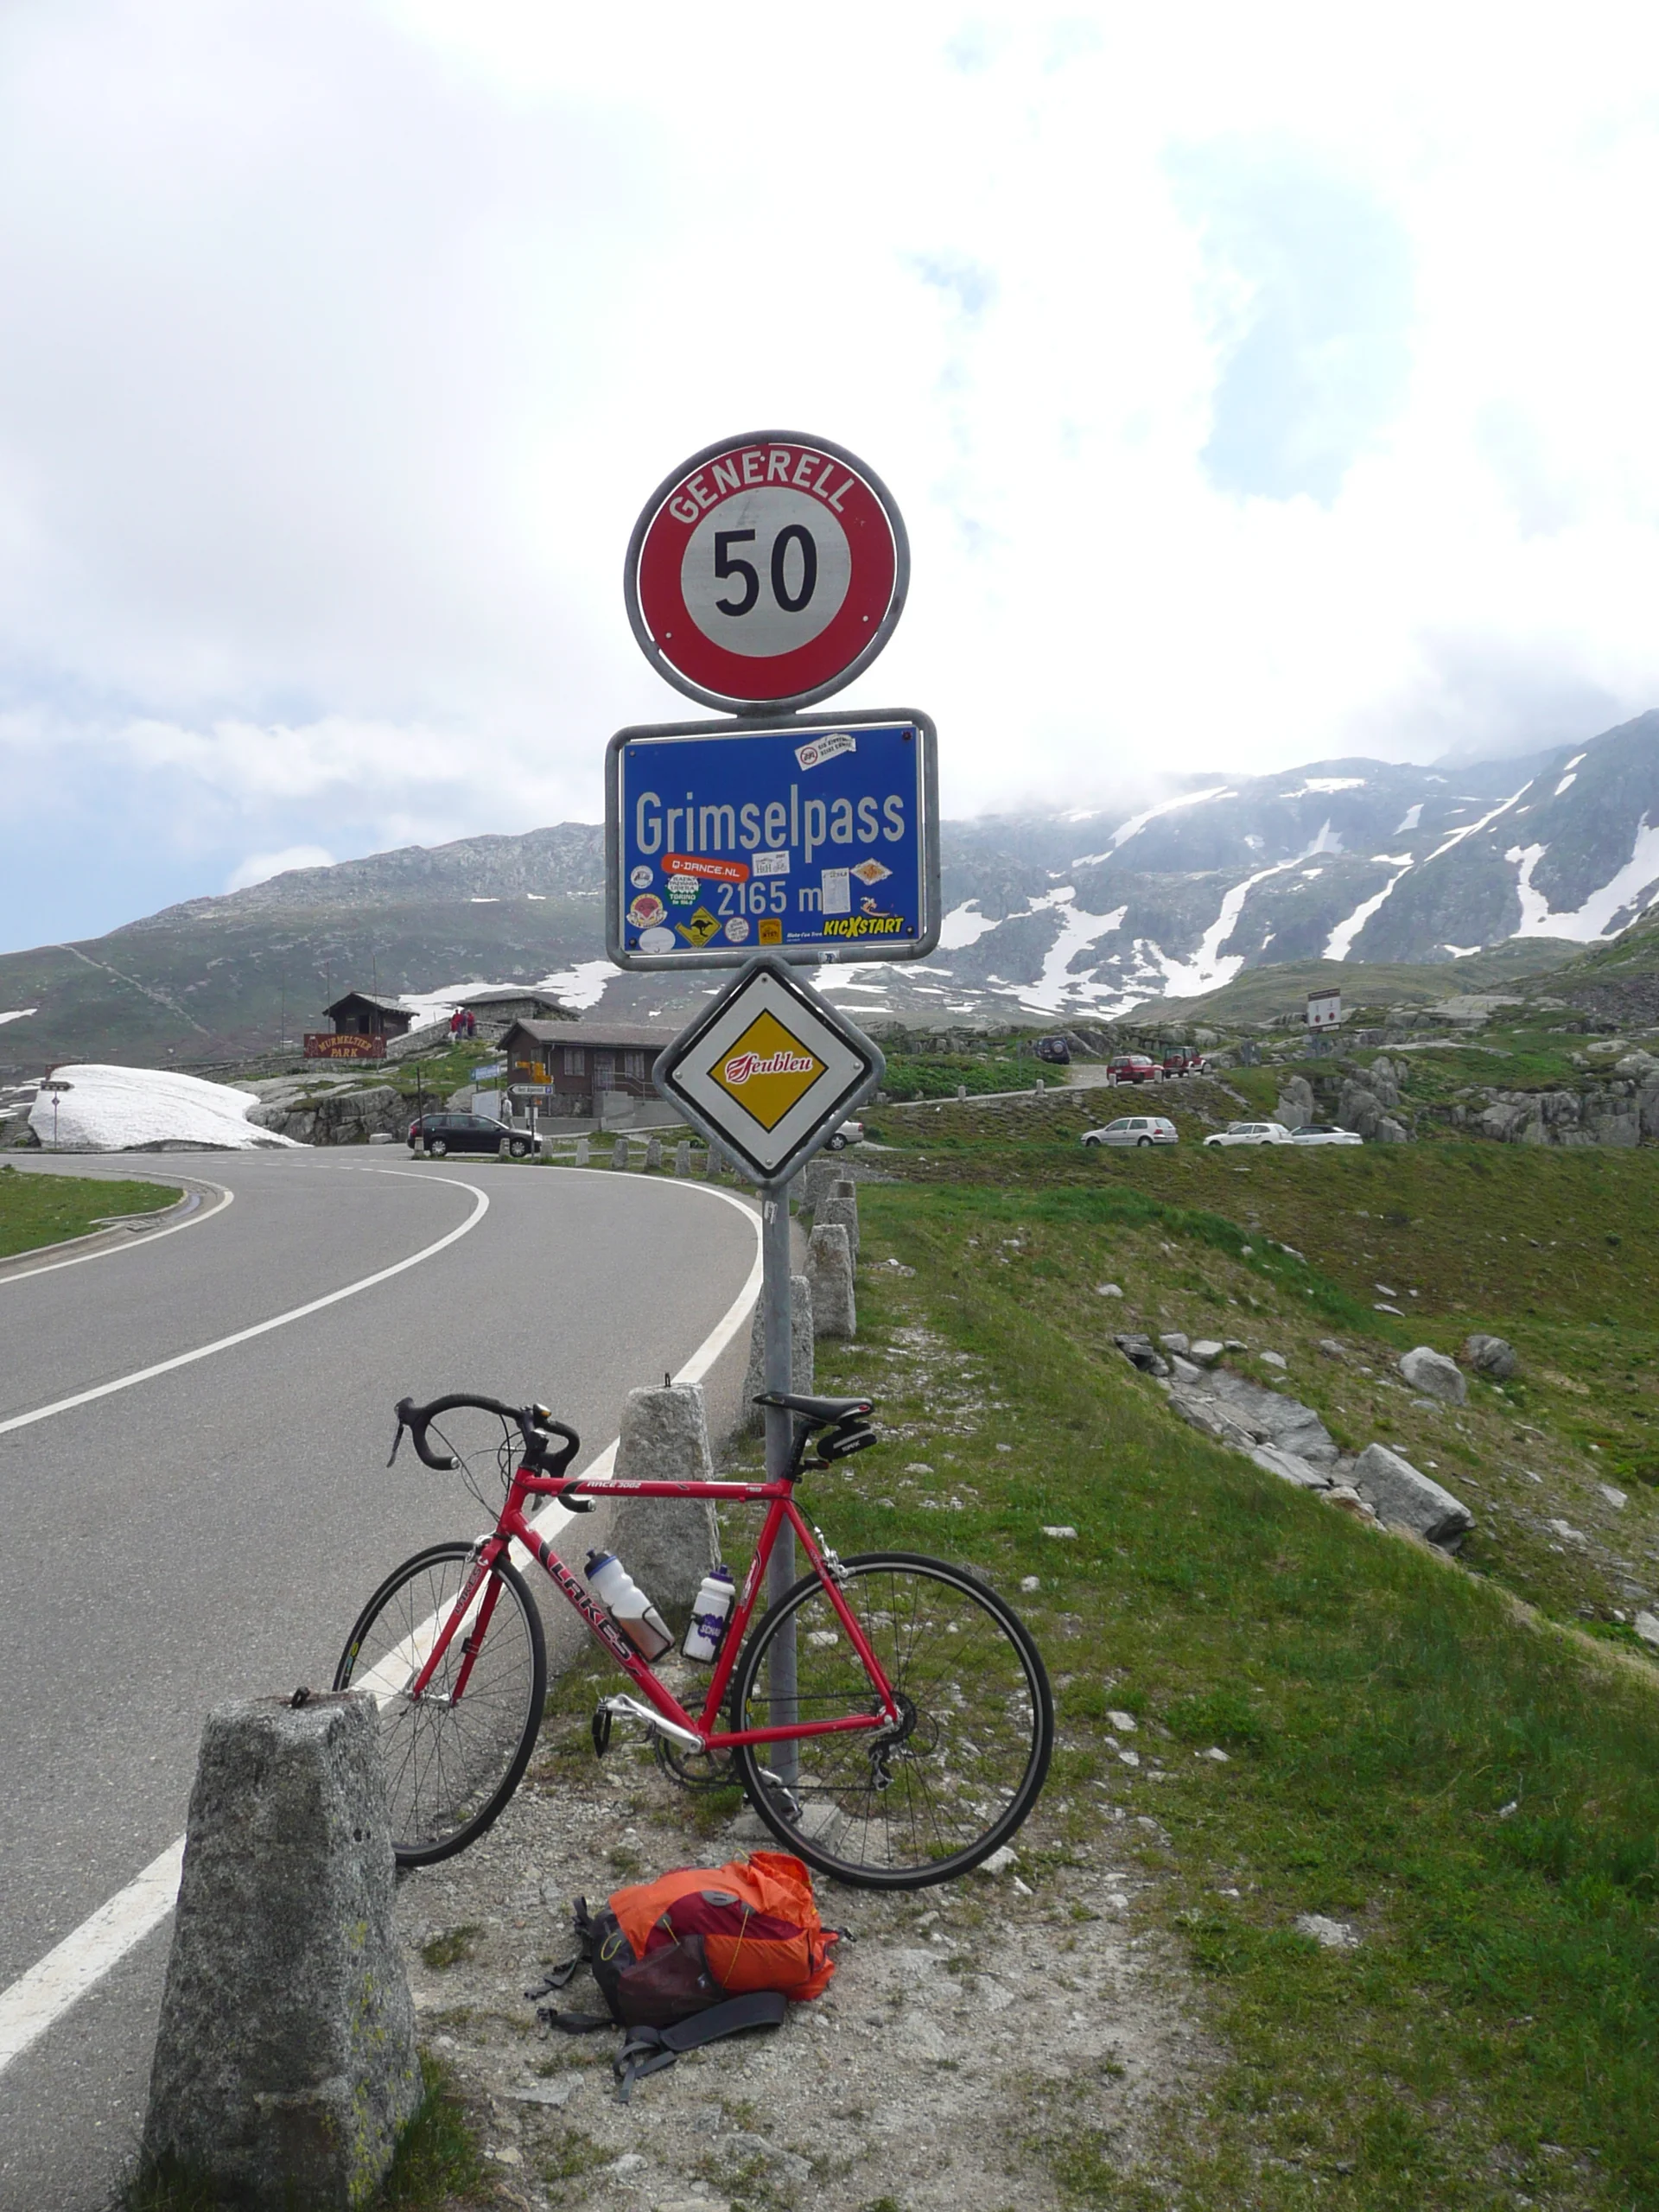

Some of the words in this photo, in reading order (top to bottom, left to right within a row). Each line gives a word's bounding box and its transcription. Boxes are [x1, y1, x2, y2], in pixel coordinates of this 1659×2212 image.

[670, 449, 855, 524] GENERELL
[714, 523, 818, 617] 50
[636, 784, 905, 864] Grimselpass
[671, 861, 741, 878] Q-DANCE.NL
[717, 880, 787, 916] 2165
[799, 887, 823, 912] m
[318, 1035, 372, 1052] MURMELTIER
[330, 1048, 358, 1058] PARK
[727, 1051, 811, 1084] feubleu
[550, 1560, 632, 1660] LAKES
